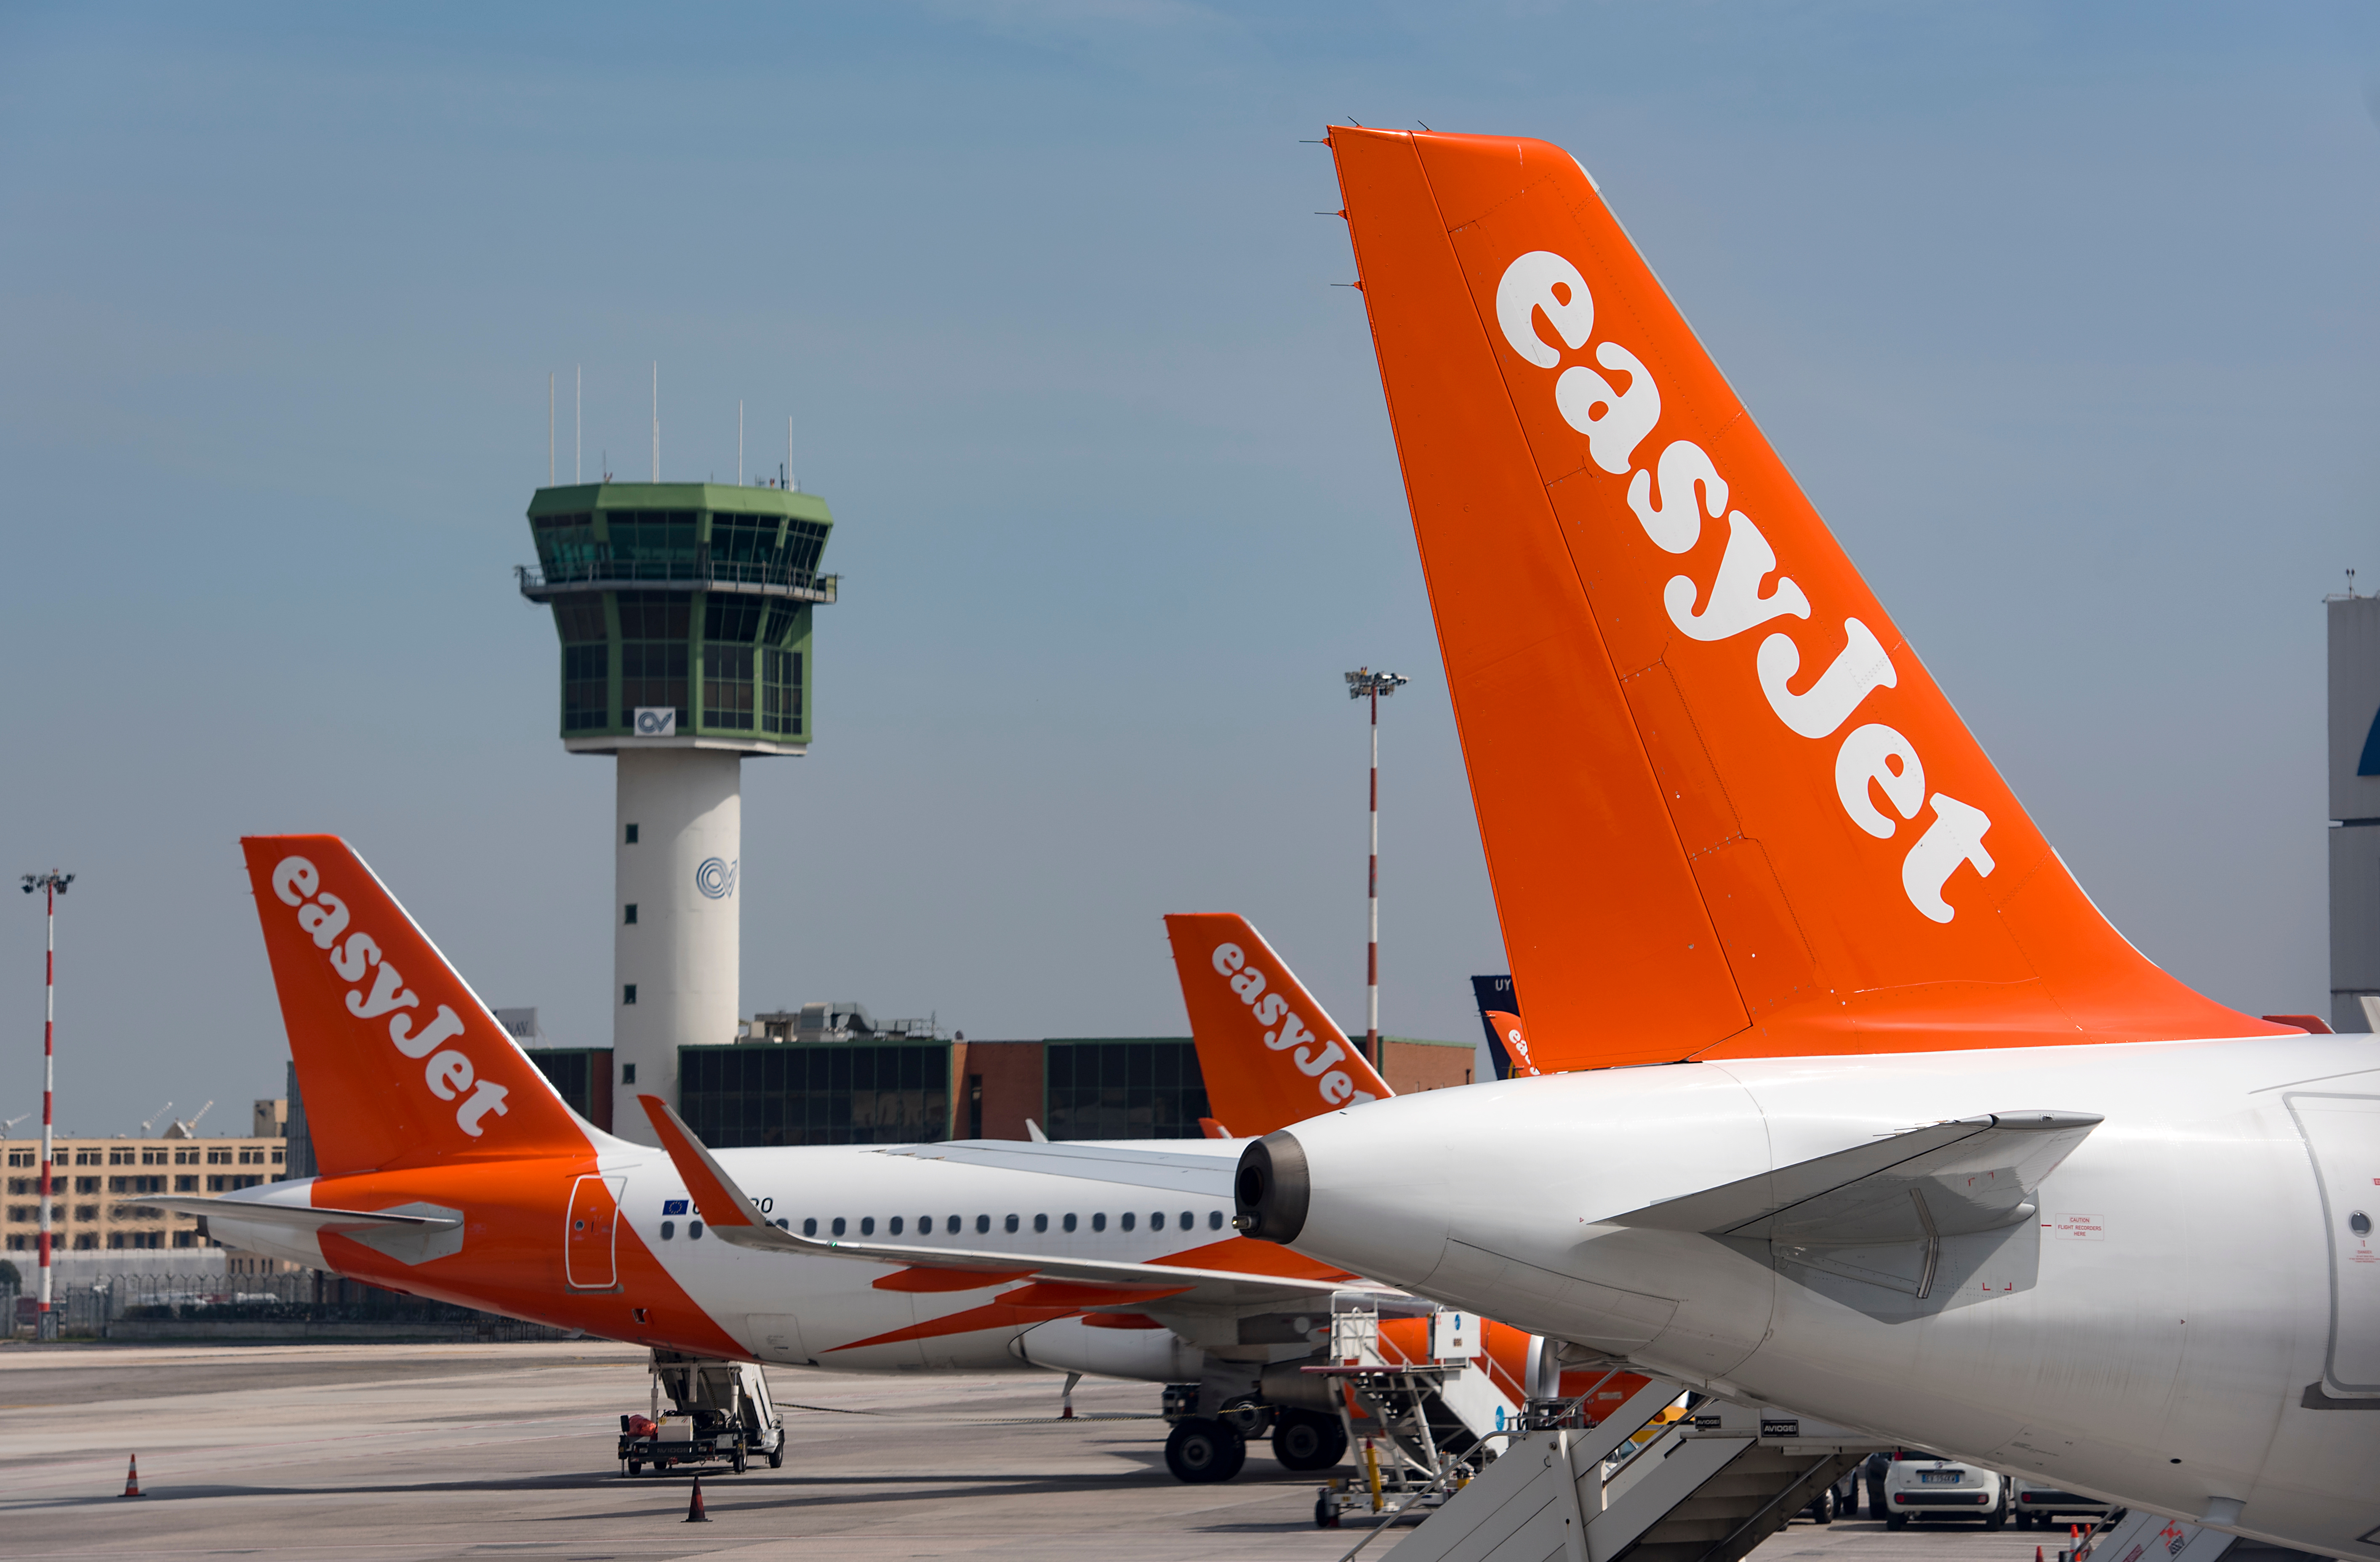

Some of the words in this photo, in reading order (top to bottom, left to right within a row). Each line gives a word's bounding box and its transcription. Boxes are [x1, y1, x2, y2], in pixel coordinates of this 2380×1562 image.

[1496, 251, 1995, 923] easyJet
[272, 856, 509, 1137] easyJet
[501, 1021, 529, 1036] NAV
